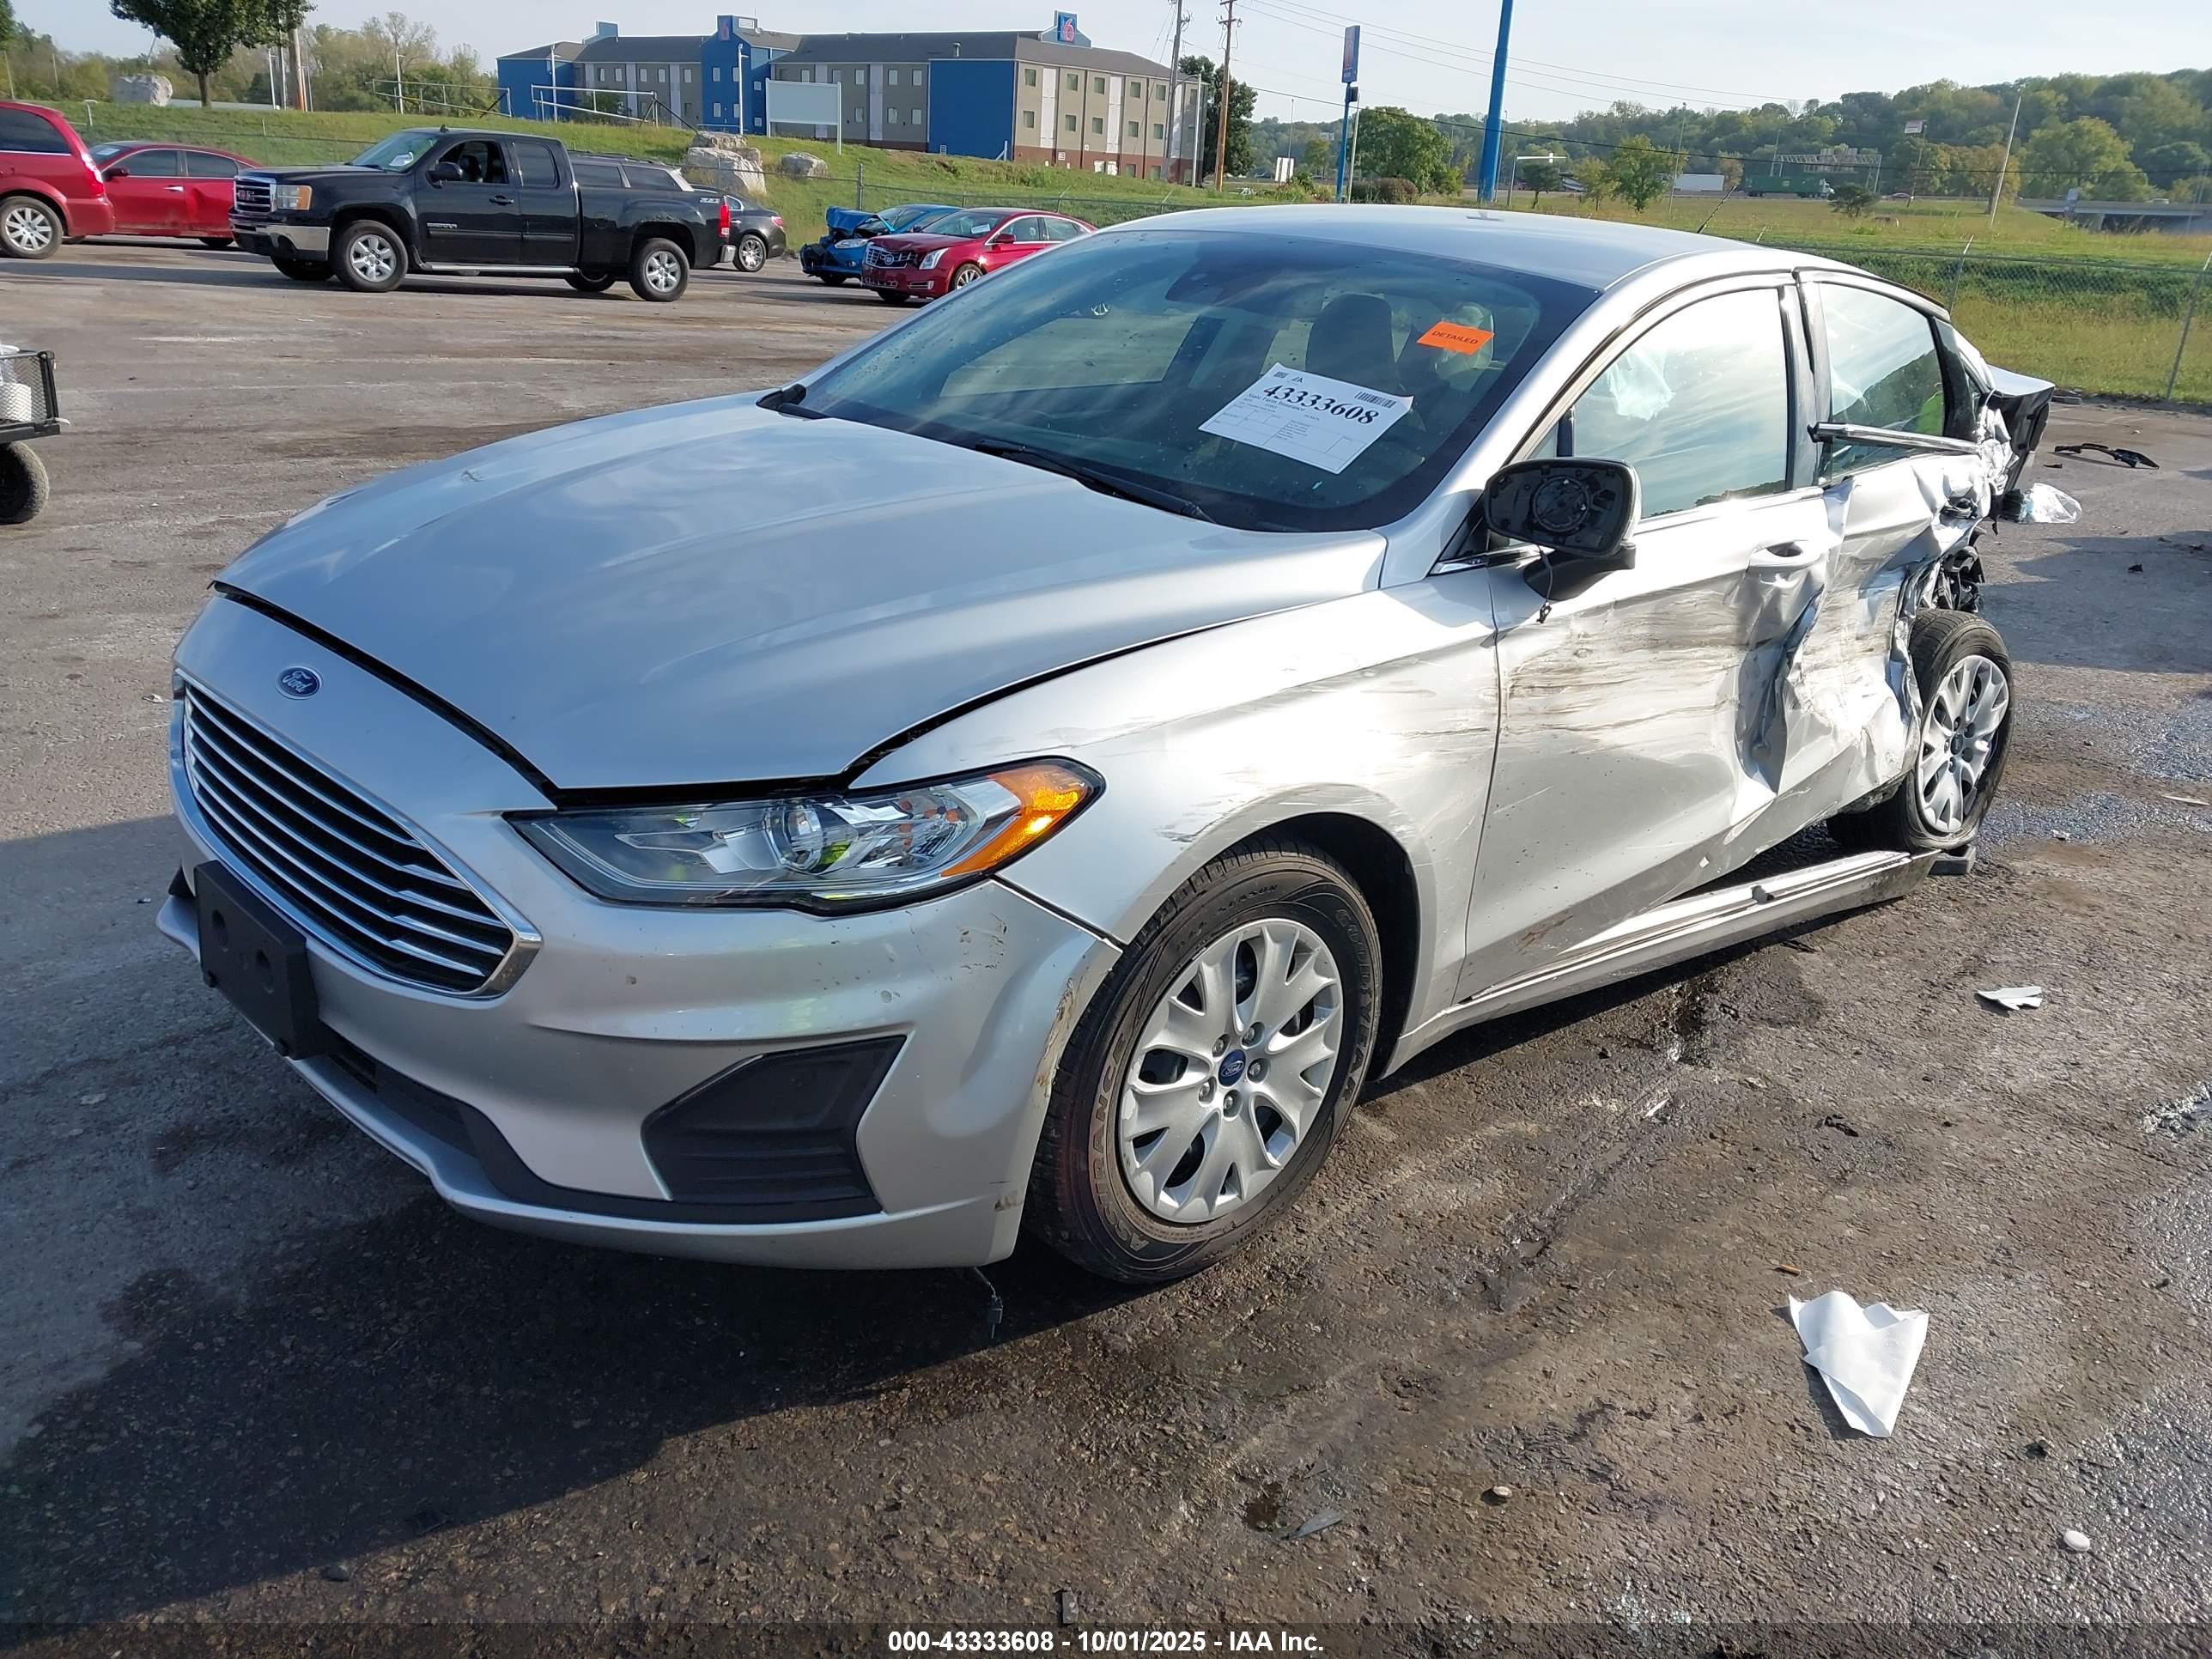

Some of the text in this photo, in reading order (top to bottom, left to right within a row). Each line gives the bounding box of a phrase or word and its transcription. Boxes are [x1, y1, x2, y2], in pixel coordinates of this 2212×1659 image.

[1431, 331, 1479, 344] DETAILED
[1263, 385, 1379, 424] 43333608
[282, 670, 313, 693] Ford
